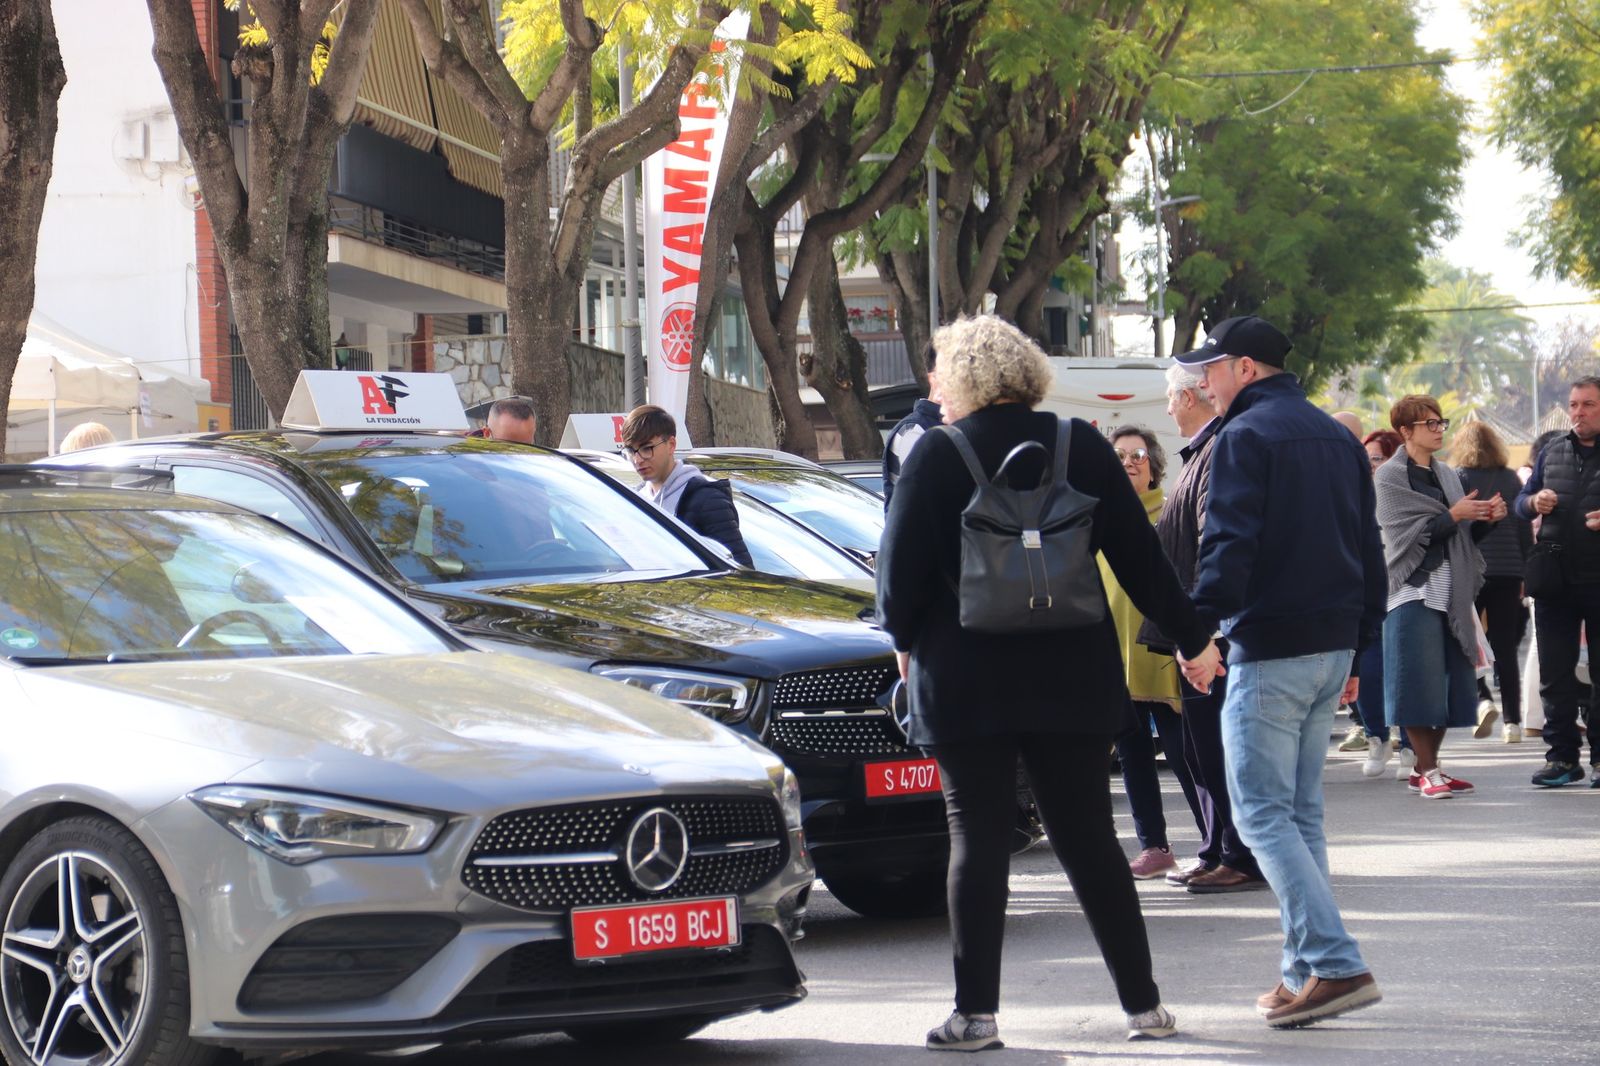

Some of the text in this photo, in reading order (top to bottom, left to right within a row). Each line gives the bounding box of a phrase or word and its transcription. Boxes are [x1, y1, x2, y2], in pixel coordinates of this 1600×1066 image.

[661, 38, 727, 295] YAMAH
[377, 416, 421, 424] FUNDACIÓN
[884, 764, 935, 791] S 4707
[594, 909, 723, 949] S 1659 BCJ
